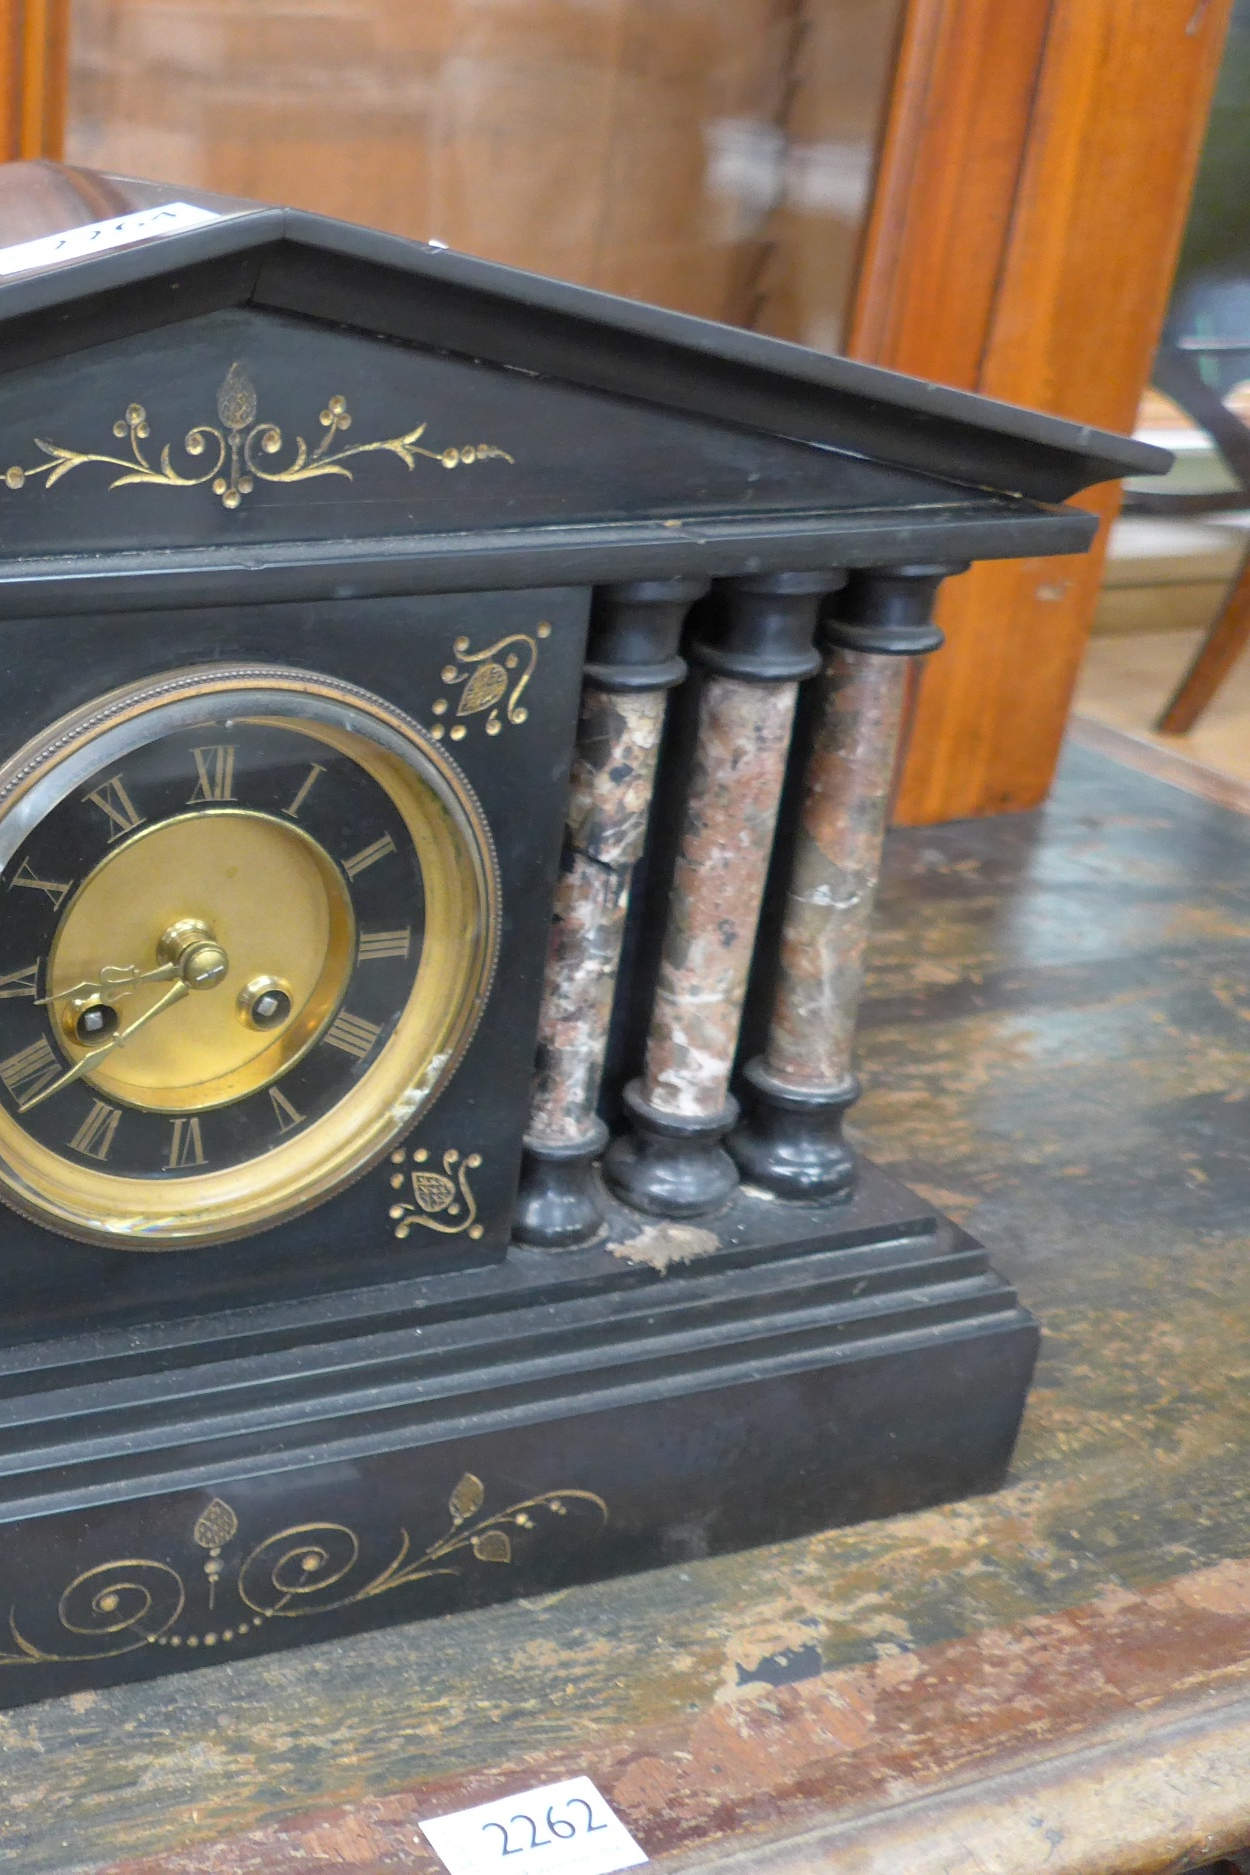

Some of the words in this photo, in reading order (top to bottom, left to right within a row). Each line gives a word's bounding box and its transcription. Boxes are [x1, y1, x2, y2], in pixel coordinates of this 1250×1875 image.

[186, 745, 240, 804] XII
[281, 762, 327, 818] I
[81, 773, 147, 844] XI
[7, 856, 74, 912] X
[340, 831, 397, 882] II
[357, 924, 411, 967] III
[319, 1005, 385, 1065] IIII
[267, 1085, 308, 1136] V
[482, 1798, 608, 1856] 2262
